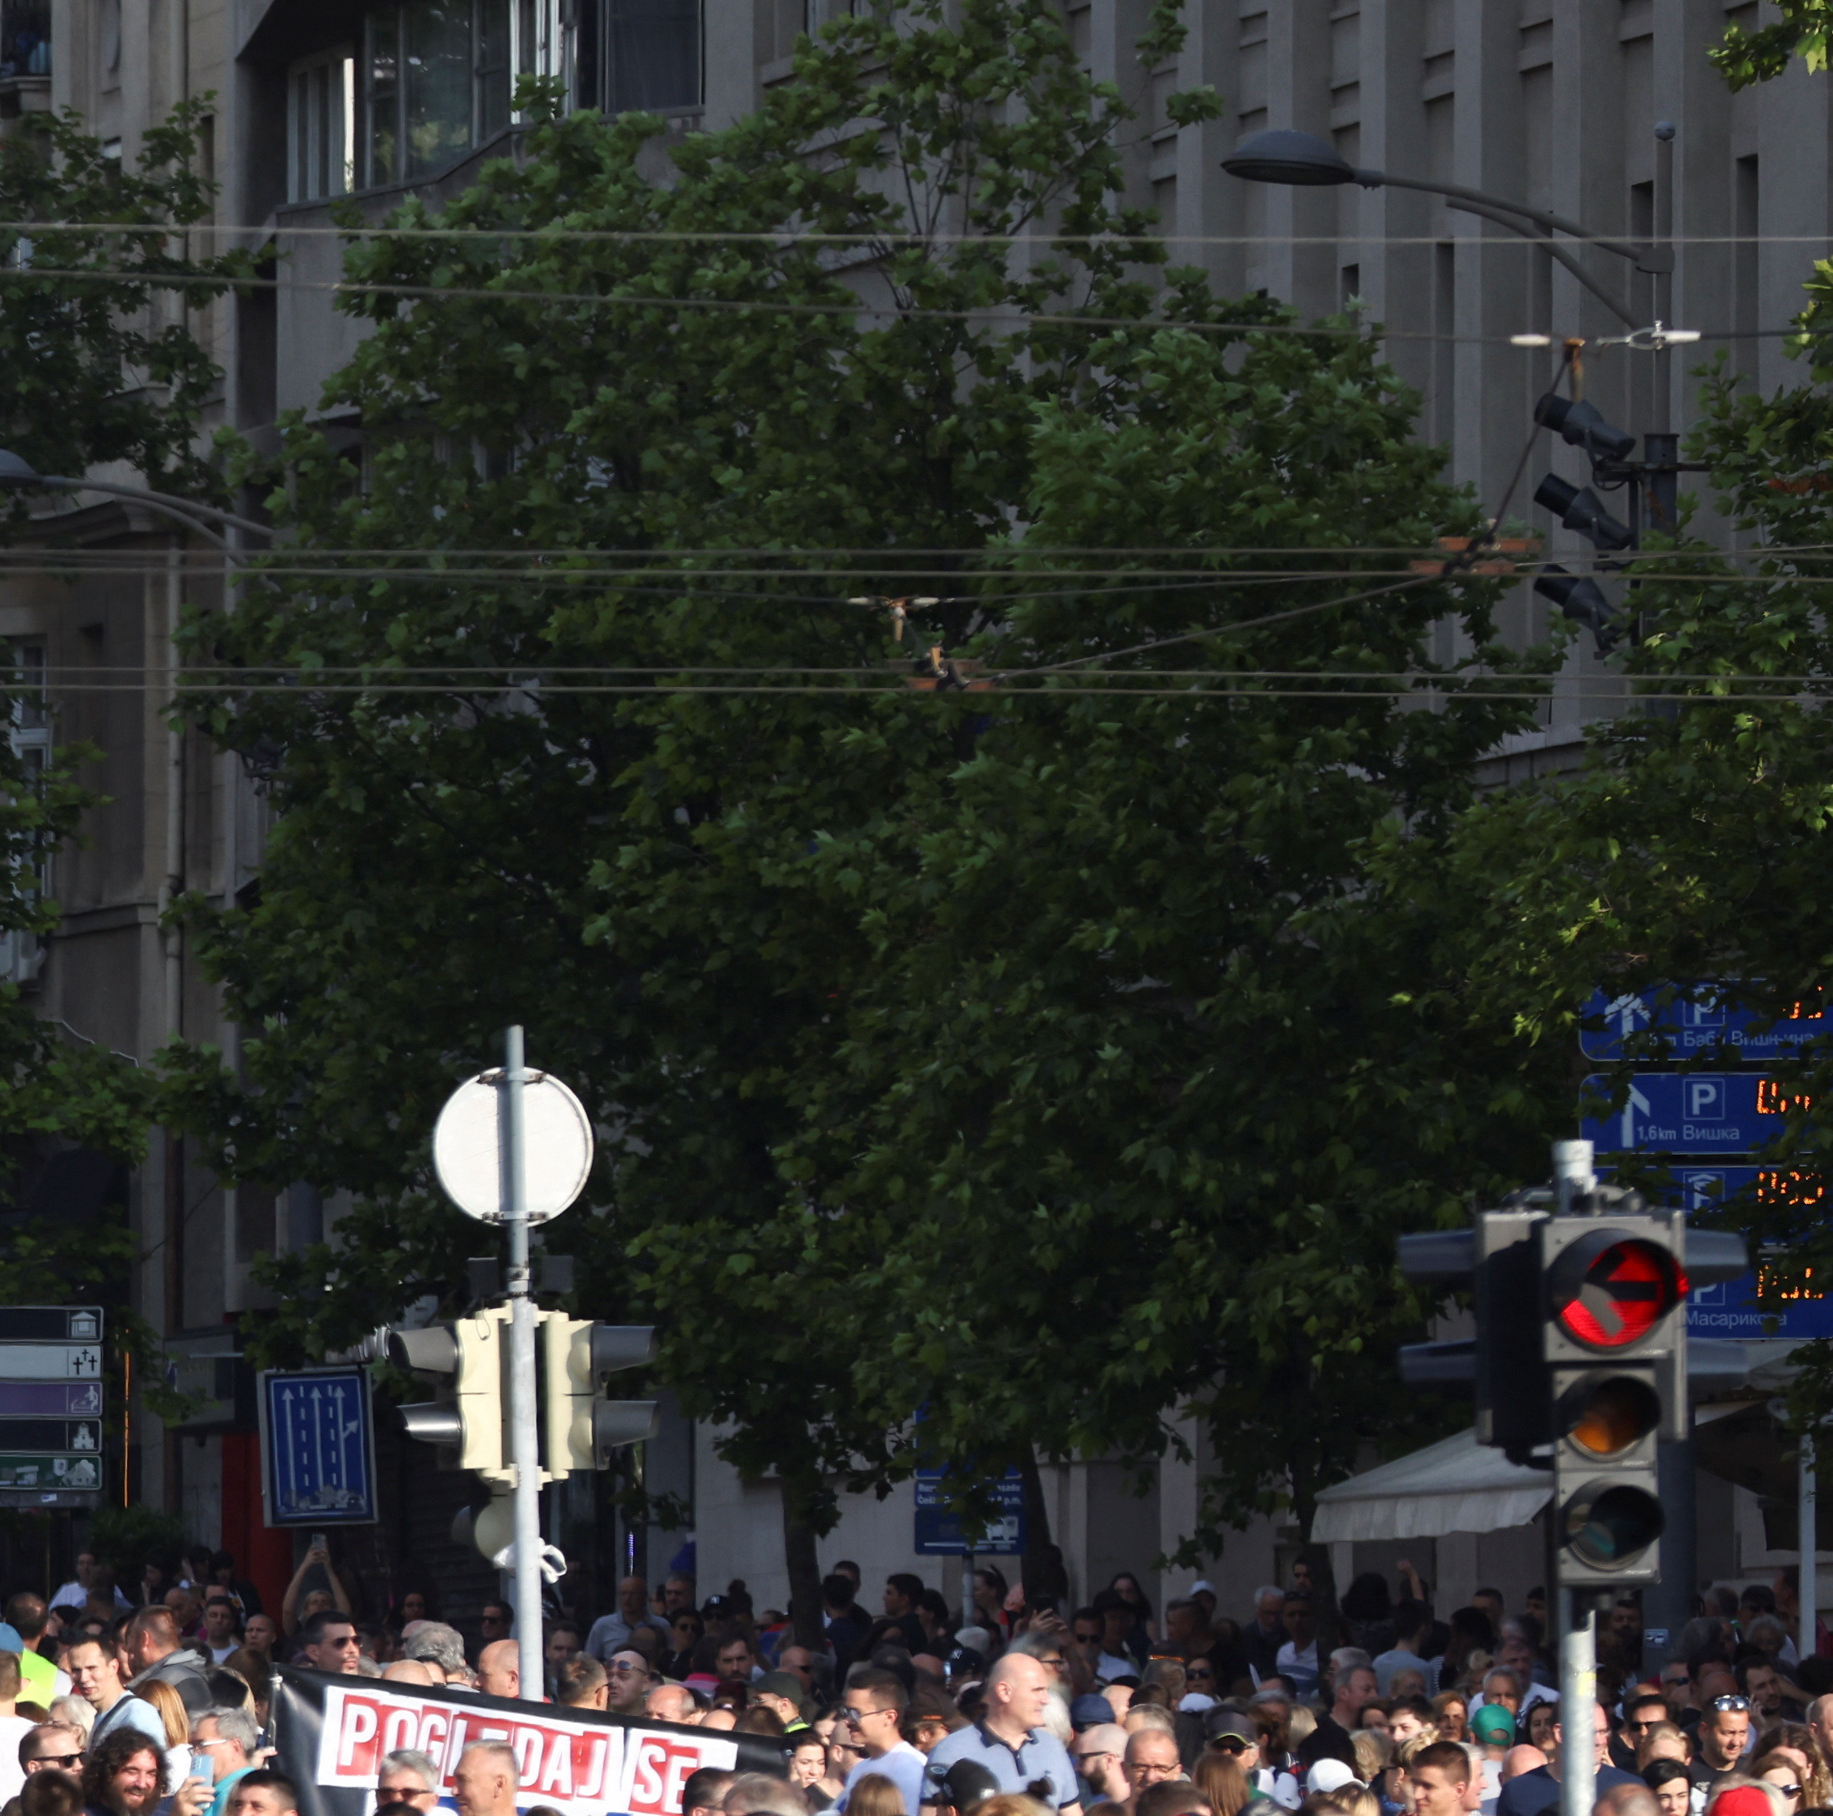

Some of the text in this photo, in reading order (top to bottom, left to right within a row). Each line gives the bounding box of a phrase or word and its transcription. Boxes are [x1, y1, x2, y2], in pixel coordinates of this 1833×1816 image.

[1683, 1030, 1725, 1047] Баб
[1692, 1084, 1717, 1116] P
[1682, 1125, 1740, 1141] Вишка
[1686, 1311, 1787, 1328] Масарикоа
[339, 1705, 700, 1815] POGLDAJ SE
